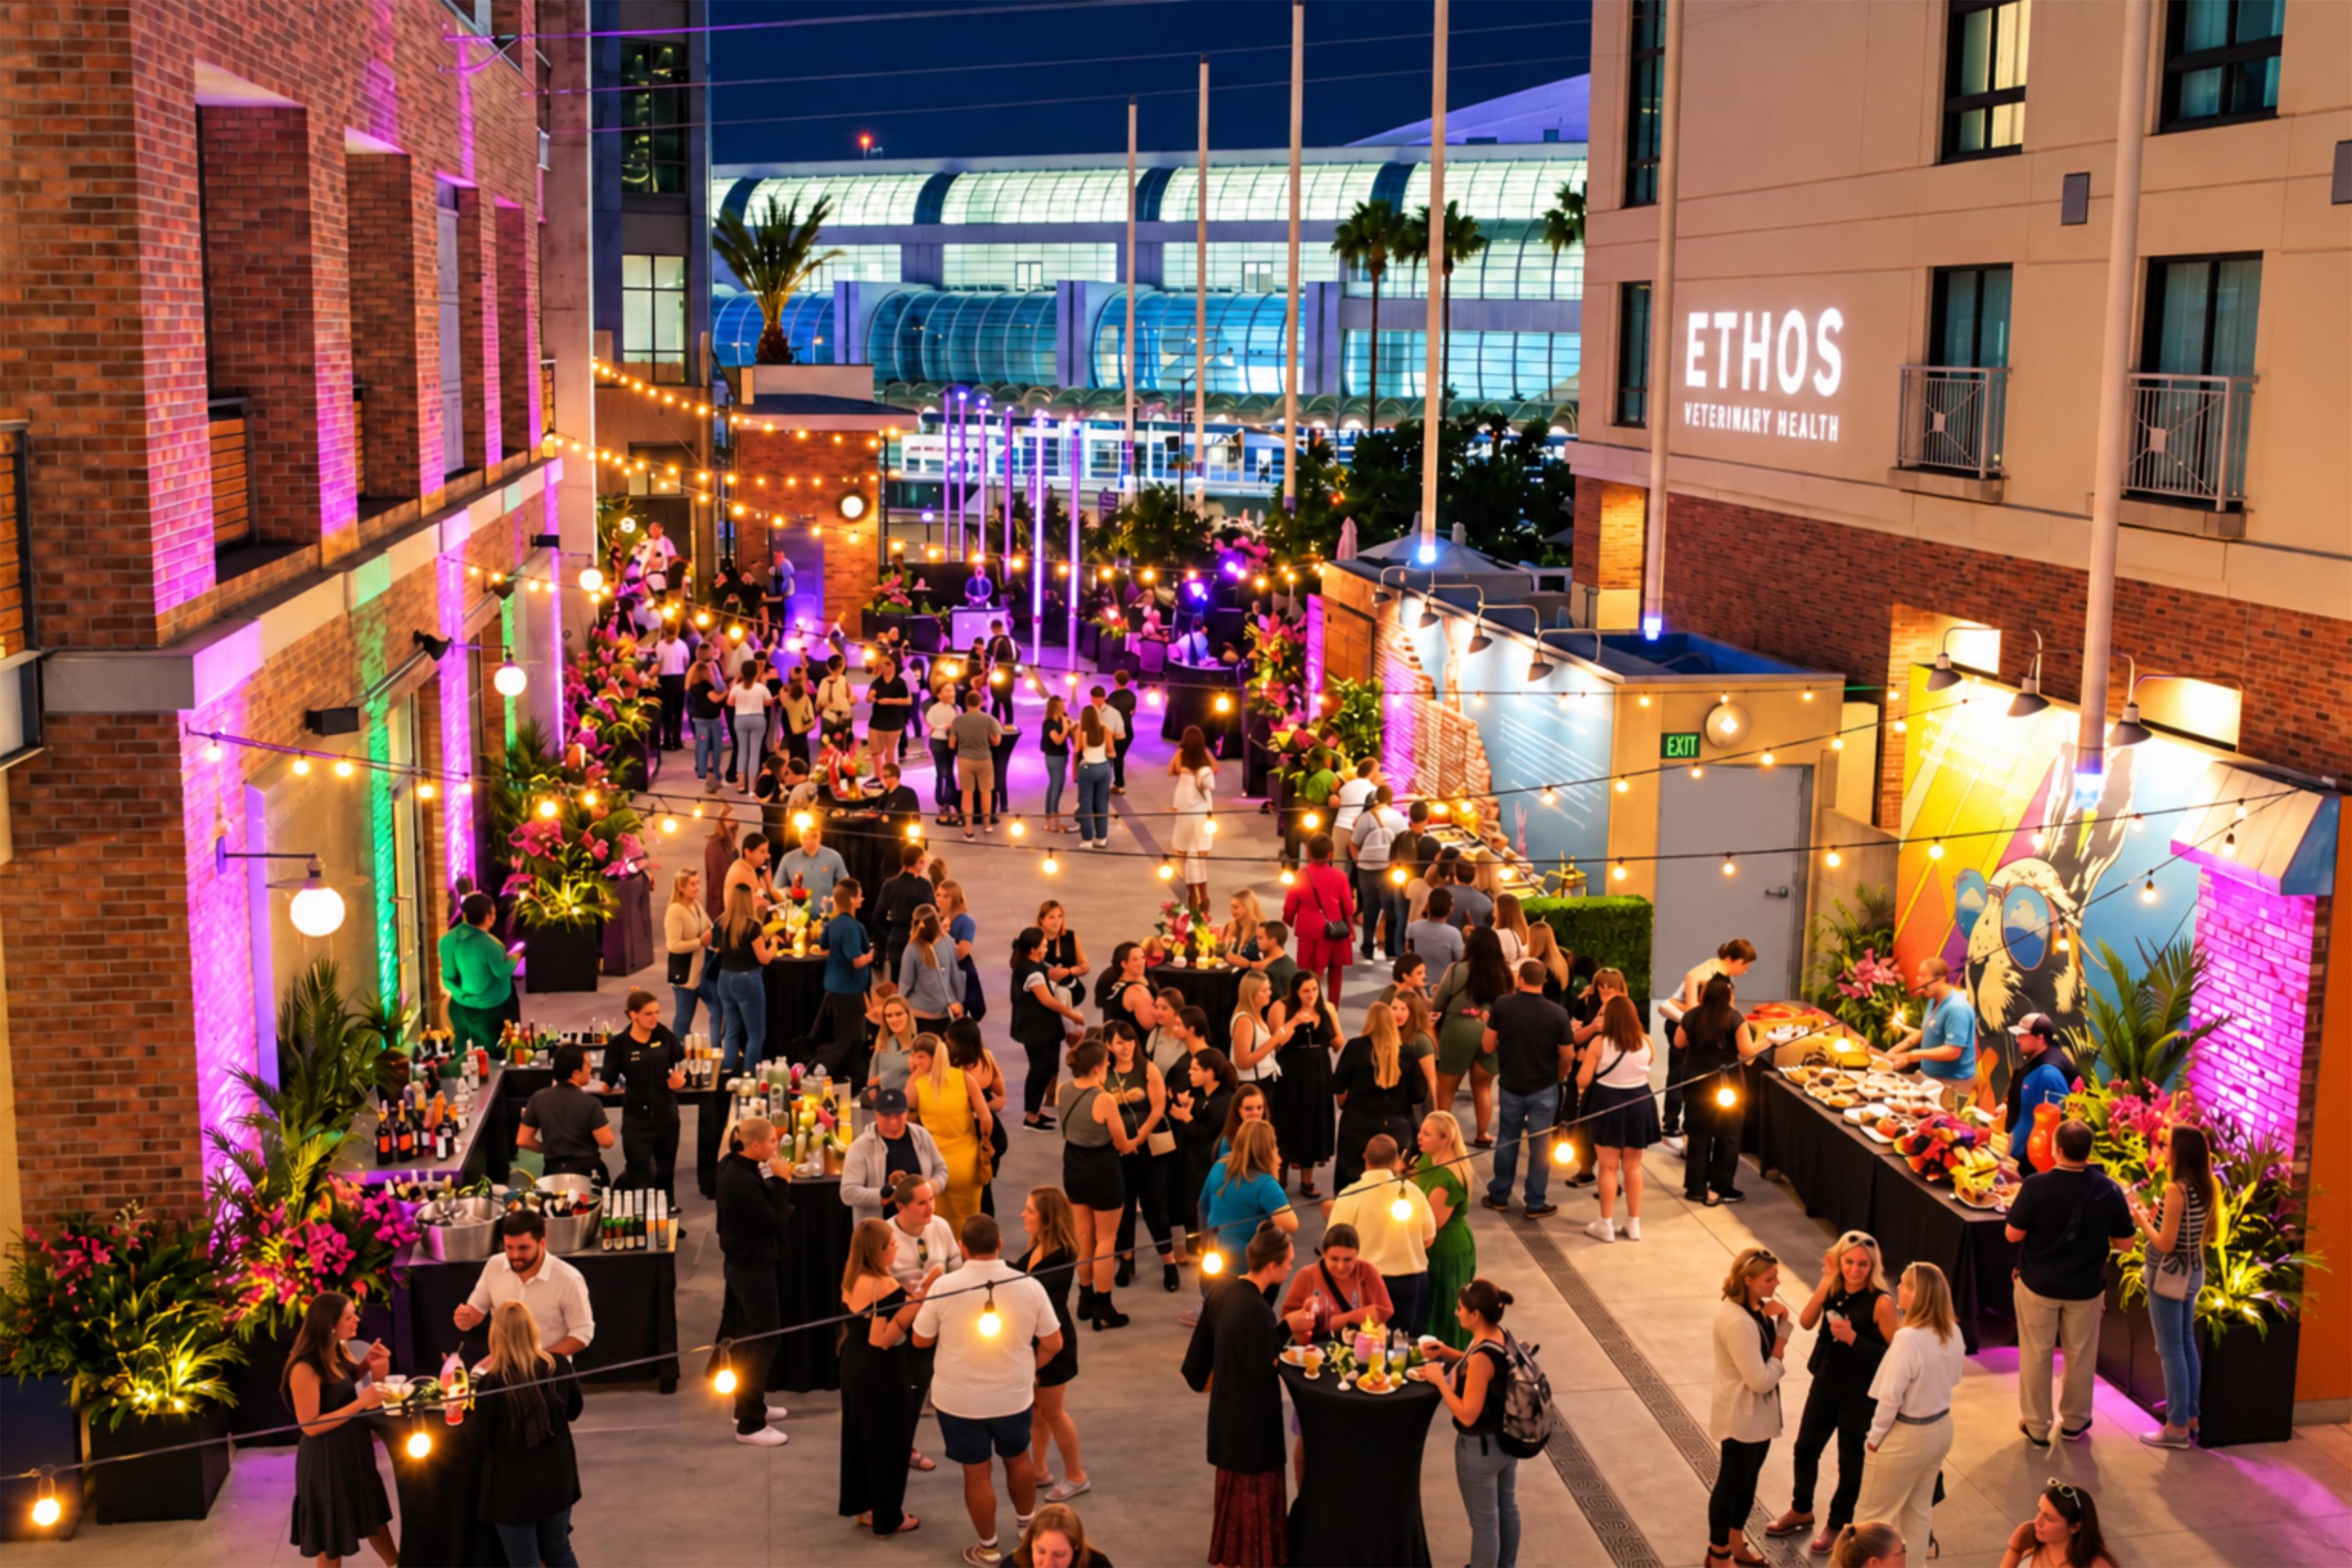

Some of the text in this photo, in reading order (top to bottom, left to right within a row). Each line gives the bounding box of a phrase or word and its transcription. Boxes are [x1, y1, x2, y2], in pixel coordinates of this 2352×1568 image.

[1686, 308, 1844, 396] ETHOS
[1685, 402, 1839, 442] VETERINARY HEALTH
[1667, 736, 1697, 756] EXIT
